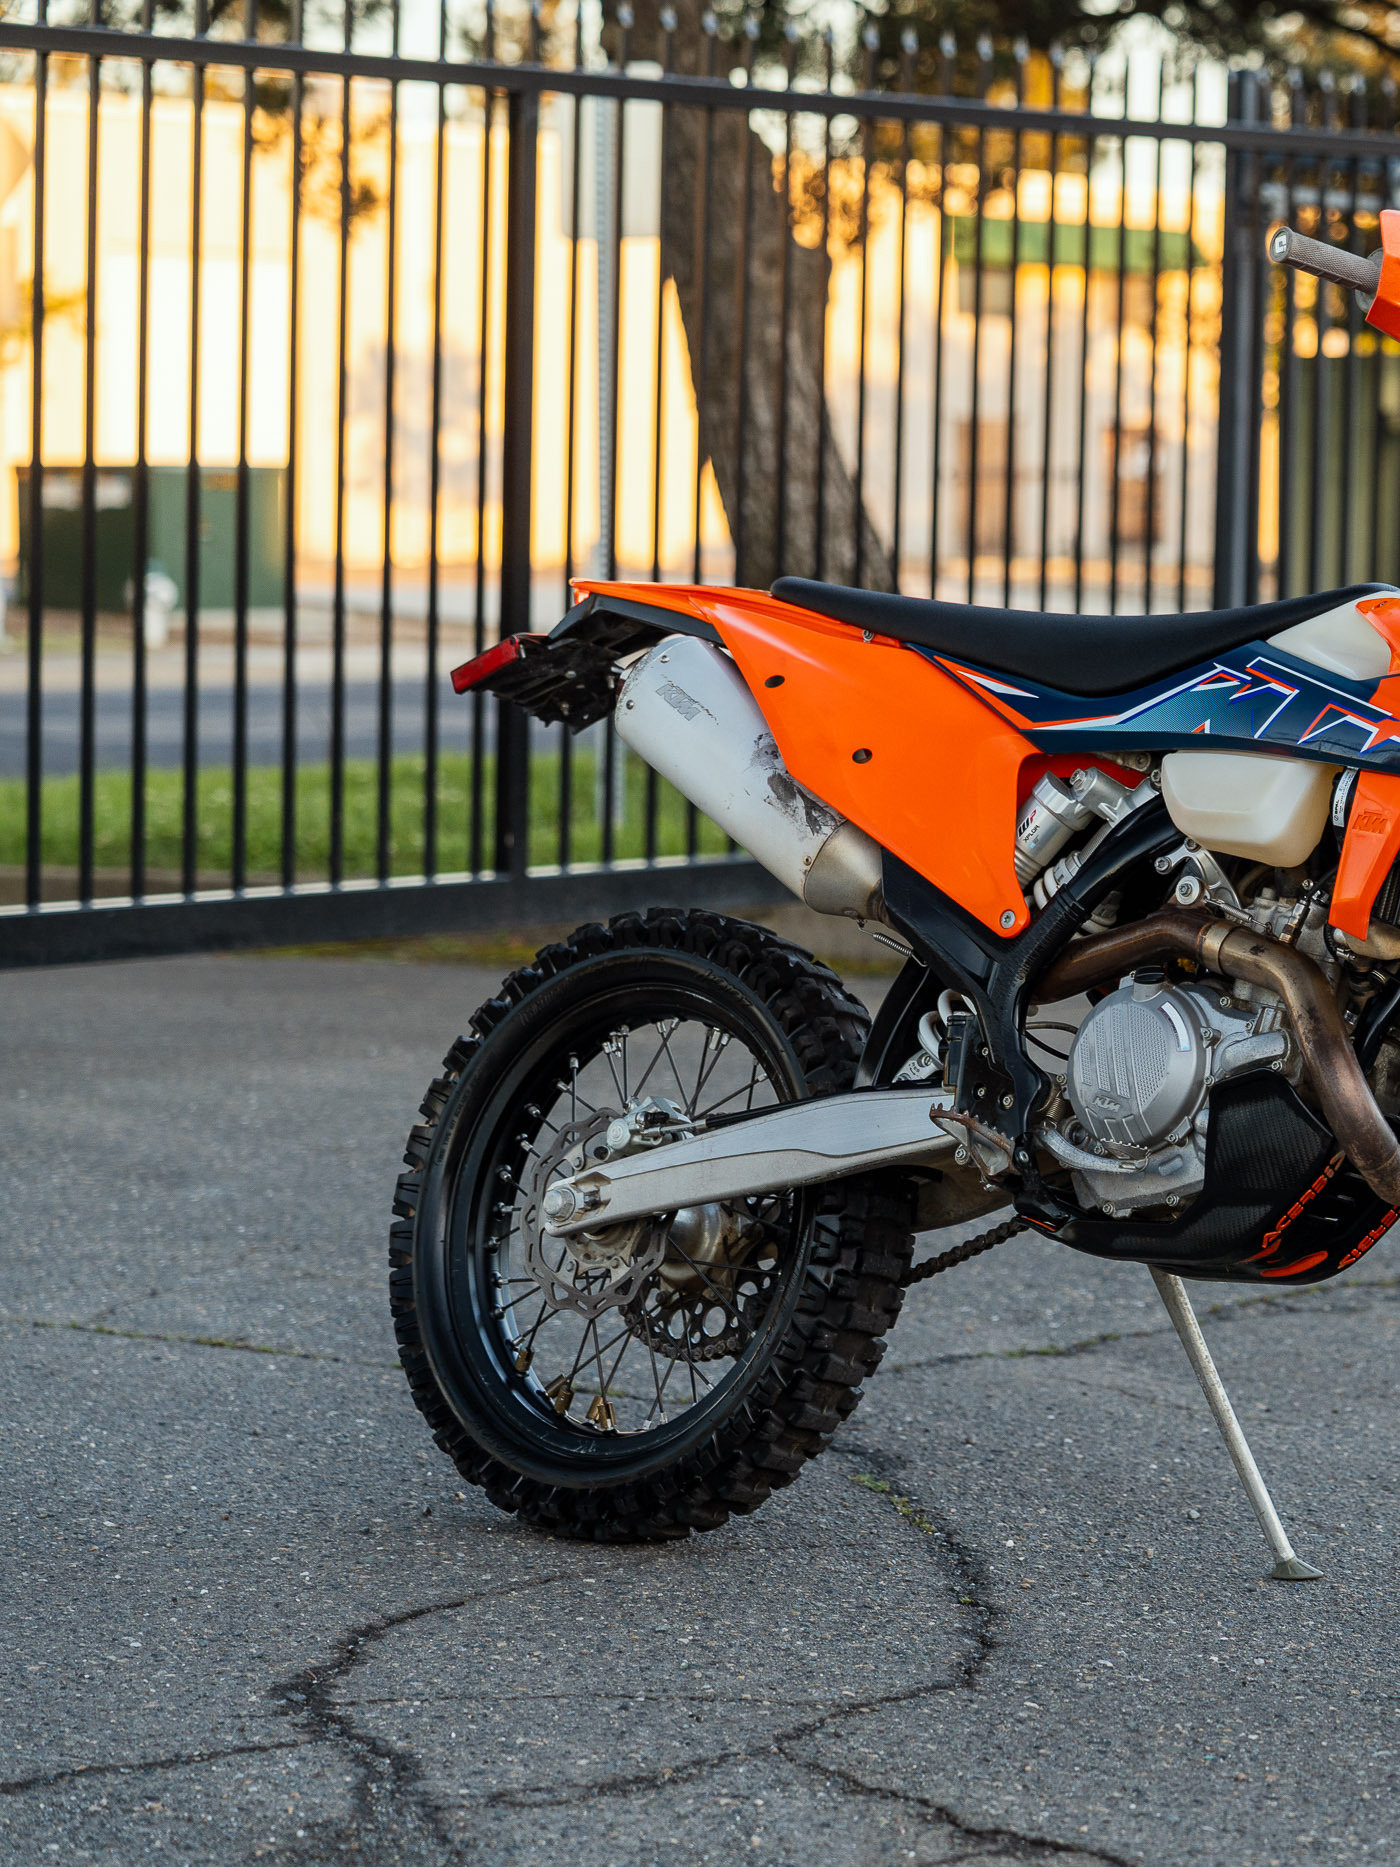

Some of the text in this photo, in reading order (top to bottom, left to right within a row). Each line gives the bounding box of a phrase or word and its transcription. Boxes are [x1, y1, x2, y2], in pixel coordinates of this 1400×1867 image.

[656, 684, 700, 721] KTM
[1018, 809, 1037, 837] WP
[1352, 808, 1388, 834] KTM
[1092, 1096, 1121, 1113] KTM
[1262, 1150, 1346, 1248] ACERBIS
